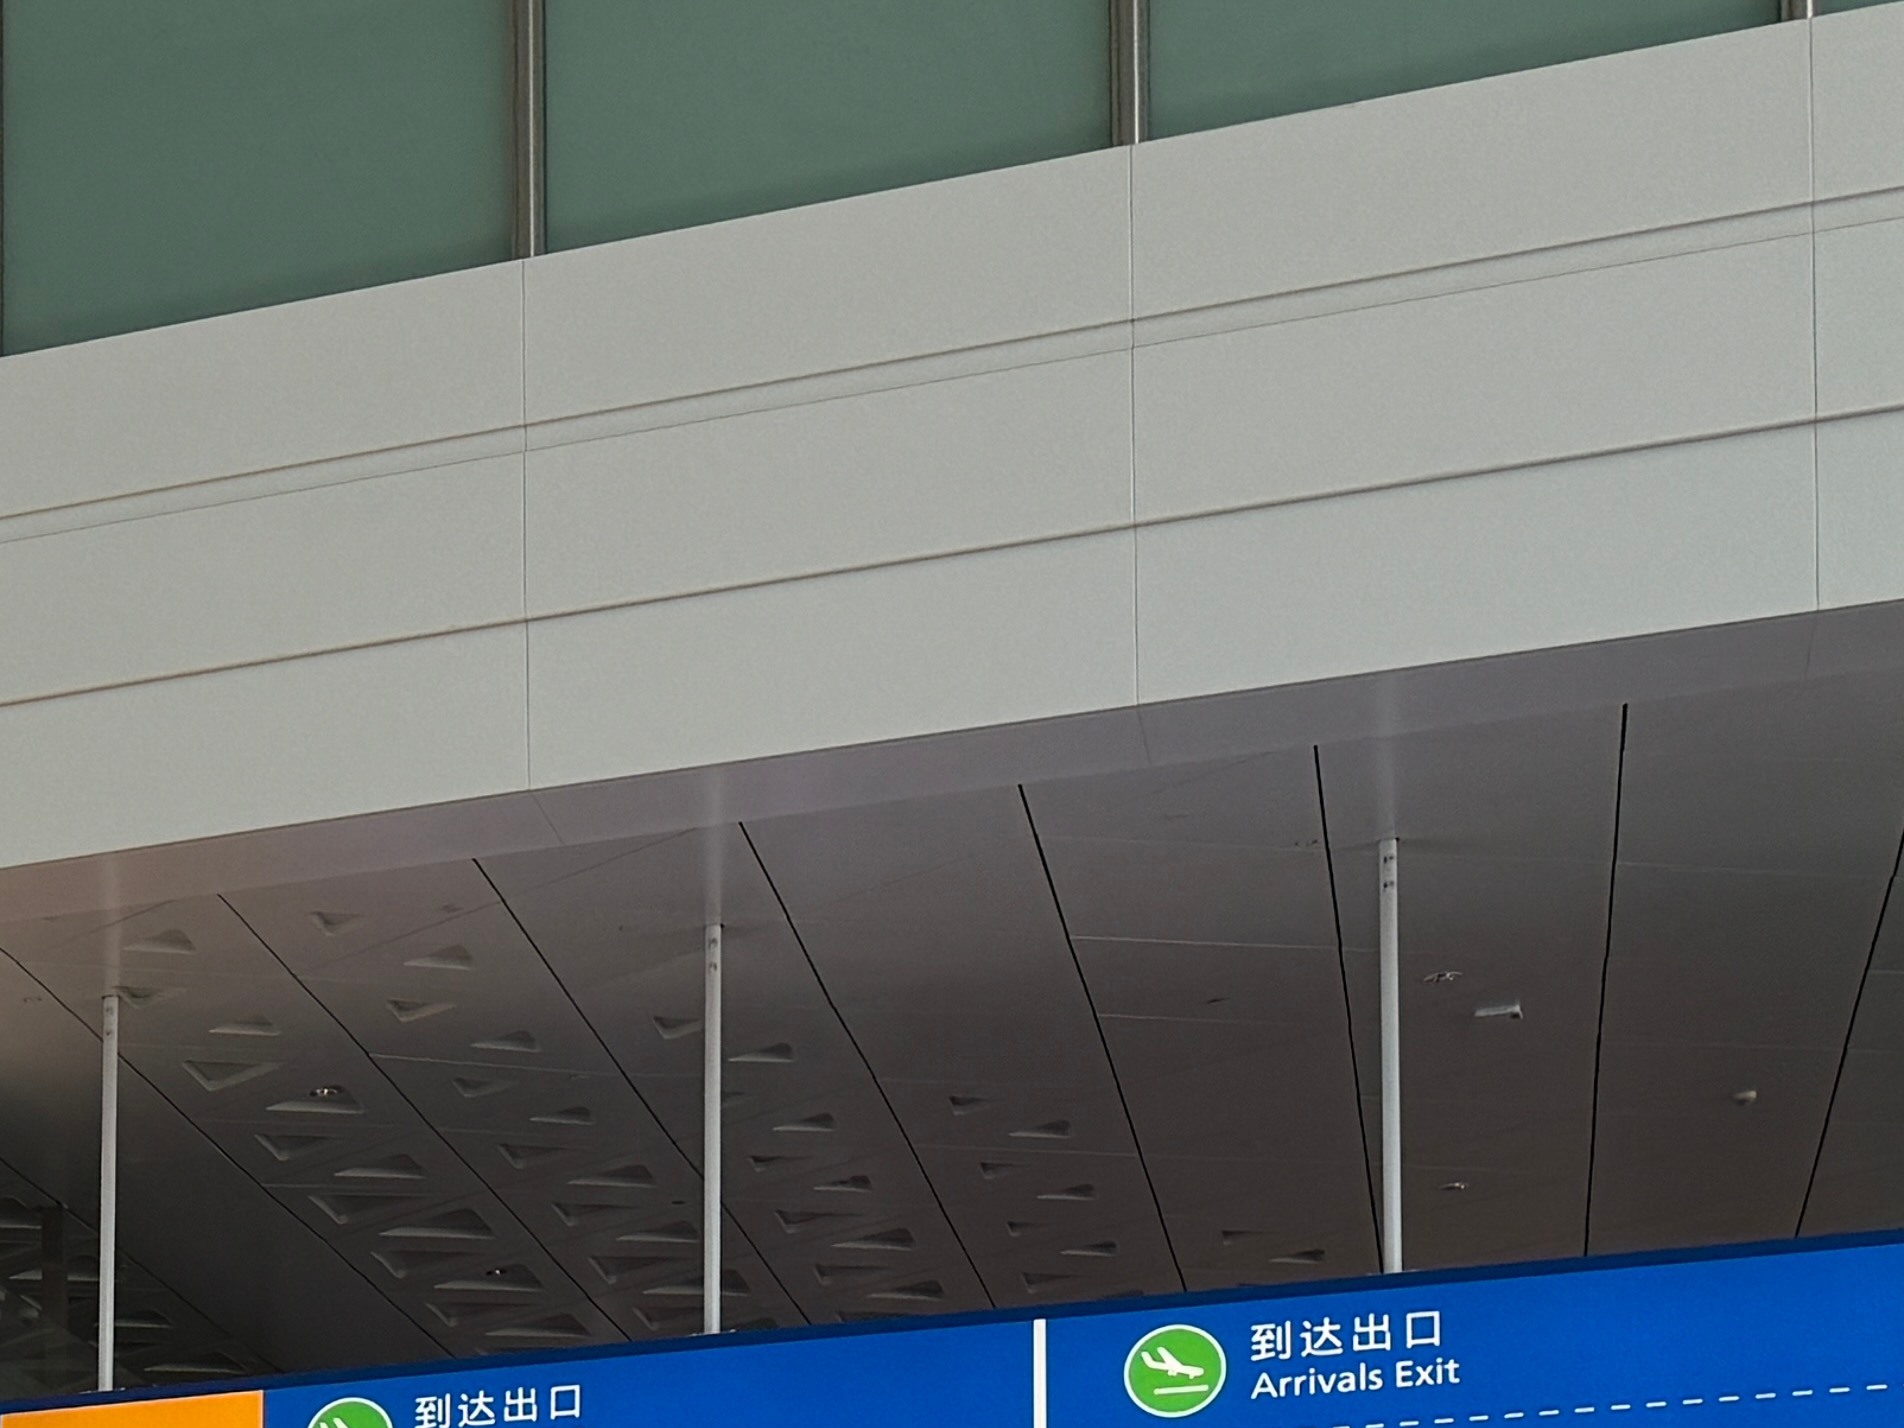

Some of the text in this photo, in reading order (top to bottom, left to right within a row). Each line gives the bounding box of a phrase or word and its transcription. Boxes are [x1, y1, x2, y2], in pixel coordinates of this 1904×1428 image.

[1251, 1310, 1442, 1362] 到达出口
[1251, 1357, 1461, 1400] Arrivals Exit
